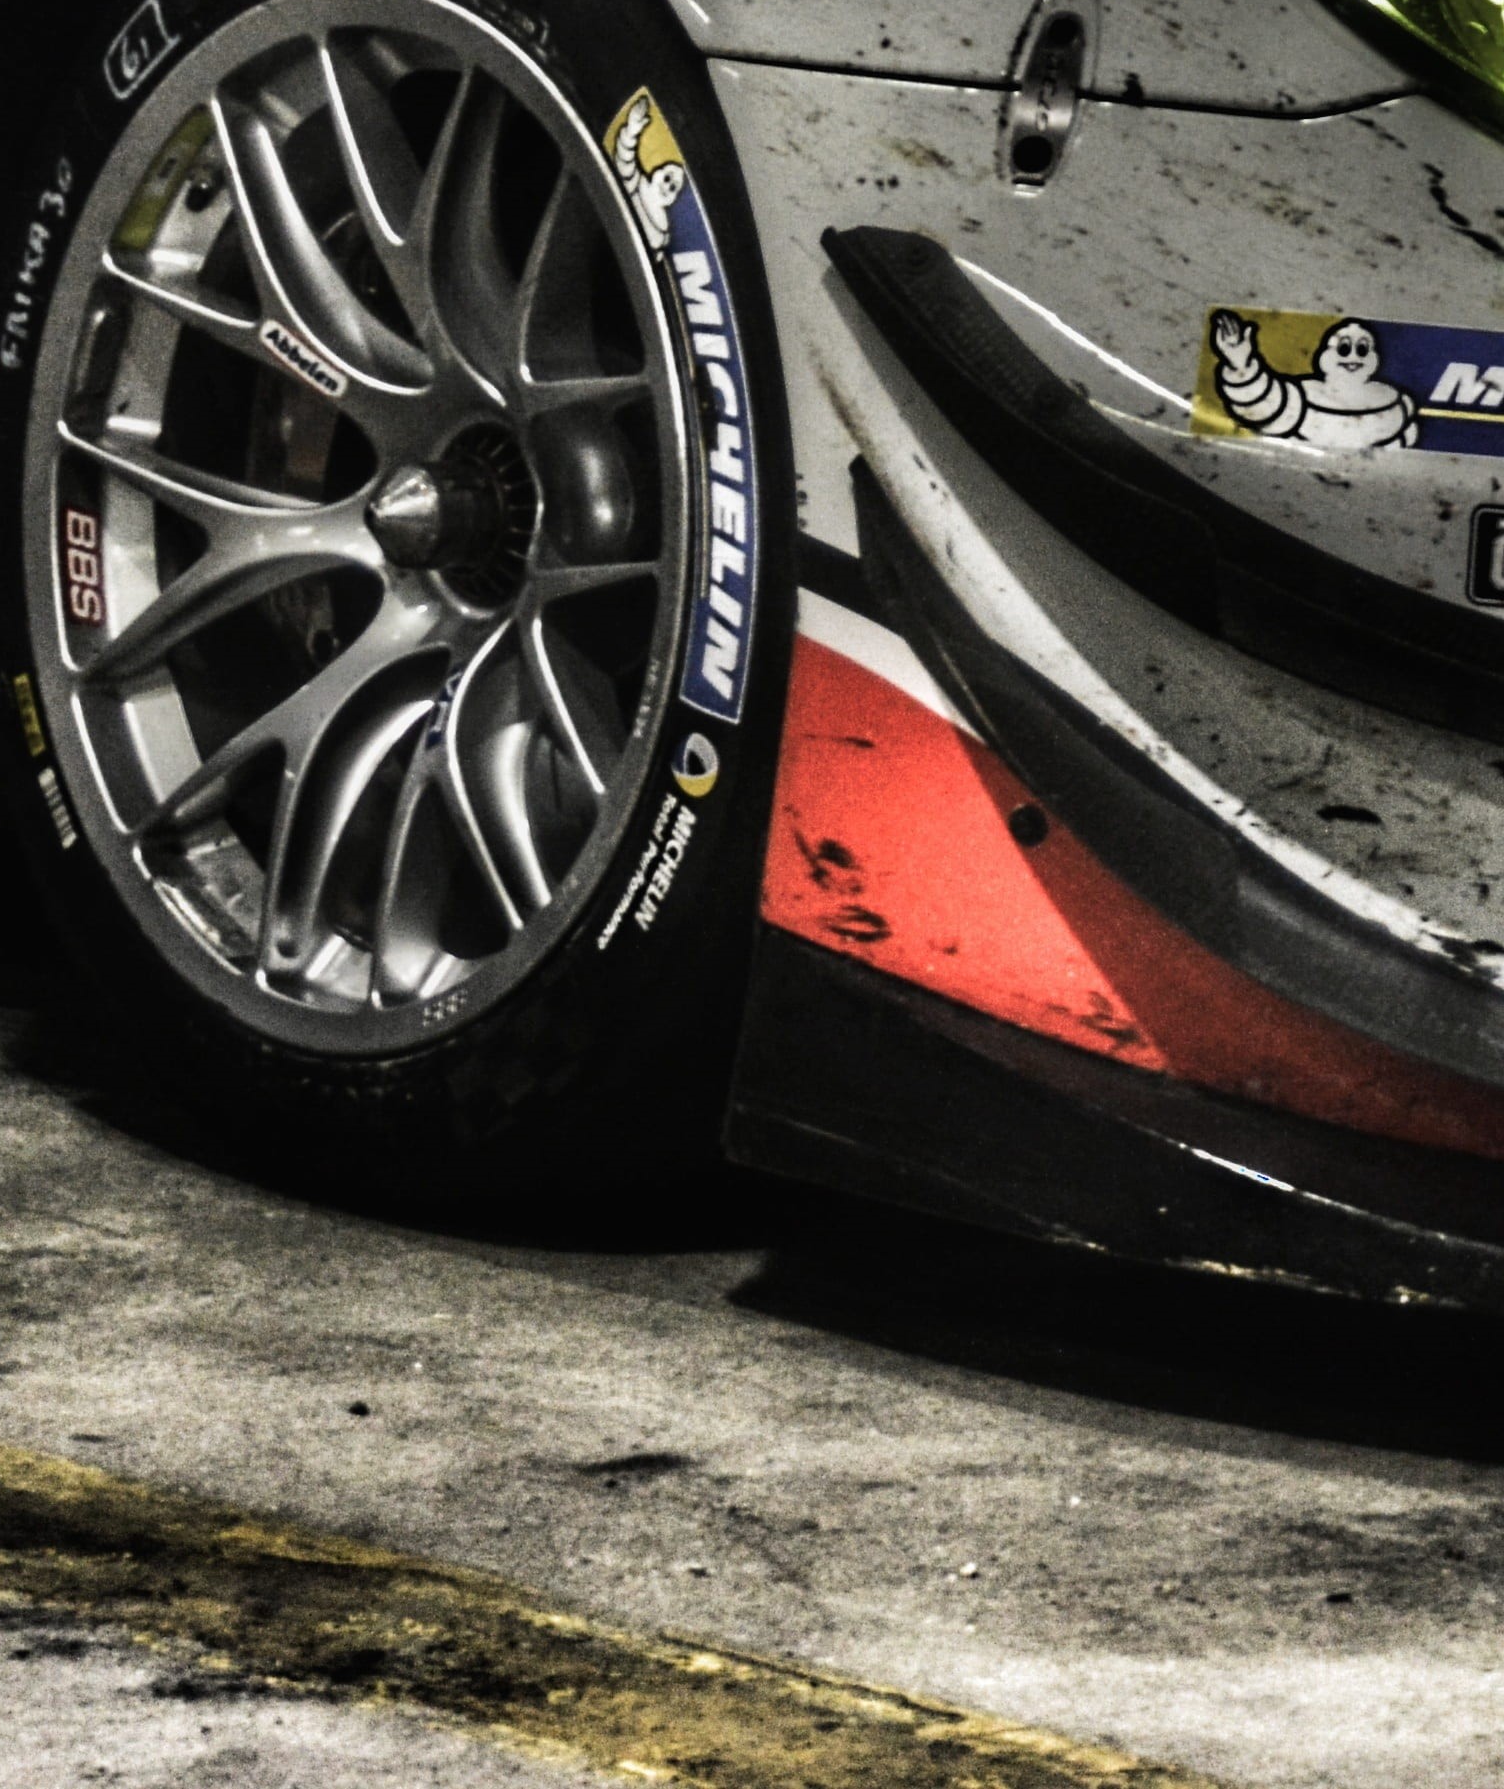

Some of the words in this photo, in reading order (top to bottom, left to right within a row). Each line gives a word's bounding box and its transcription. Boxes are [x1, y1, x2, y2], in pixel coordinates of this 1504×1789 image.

[672, 250, 747, 701] MICHELIN
[65, 508, 103, 622] BBS
[633, 804, 697, 932] MICHELIN
